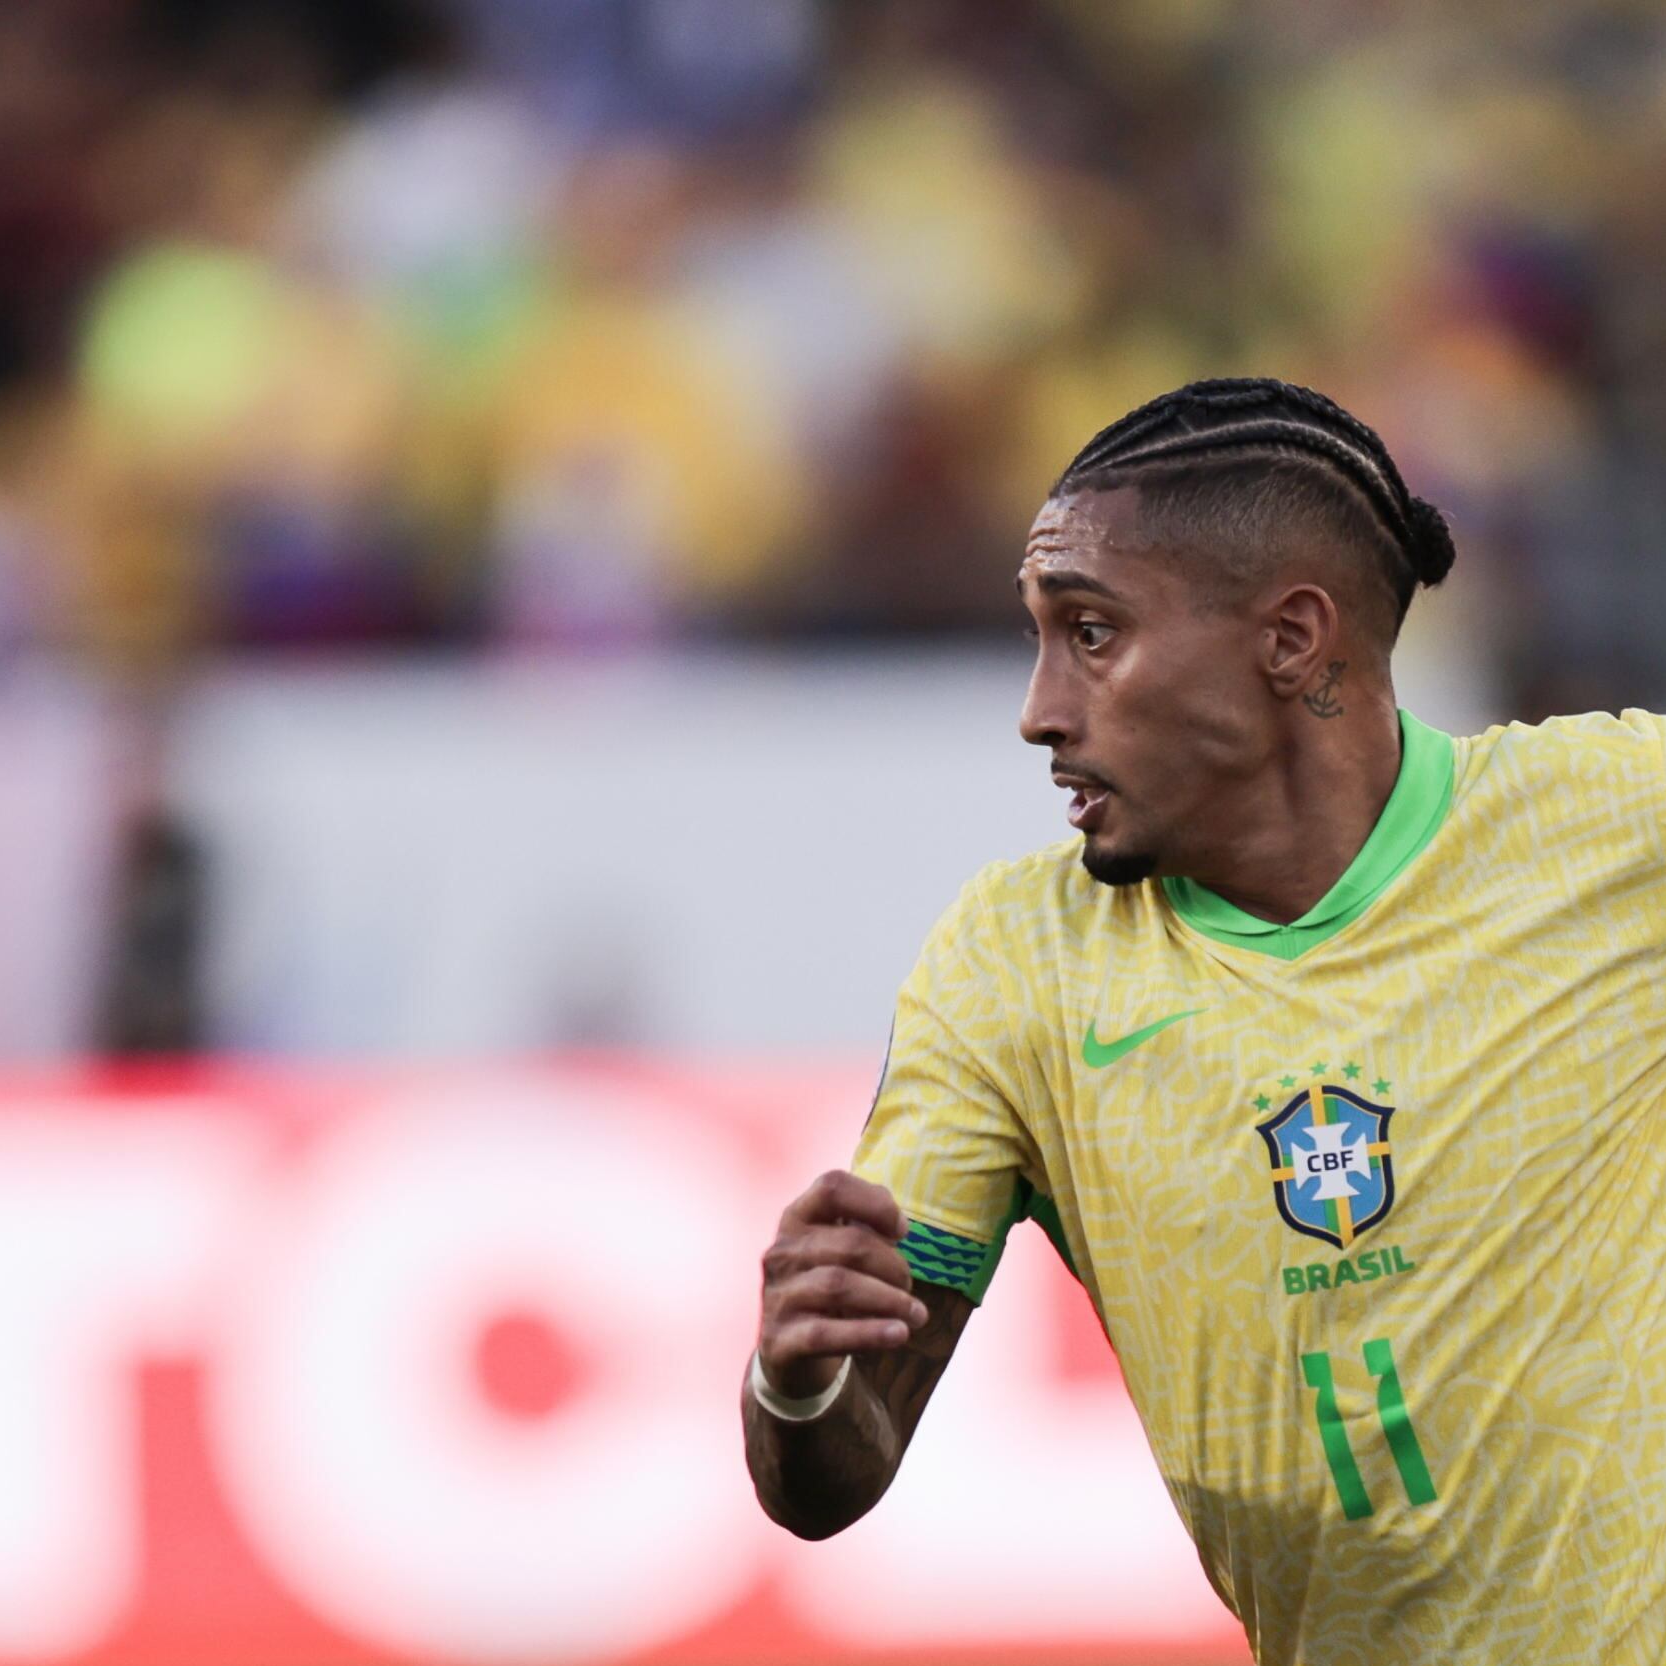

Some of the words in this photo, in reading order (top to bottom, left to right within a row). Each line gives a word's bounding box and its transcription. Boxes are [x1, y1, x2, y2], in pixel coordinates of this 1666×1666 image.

[1307, 1150, 1354, 1173] CBF
[1283, 1245, 1415, 1295] BRASIL
[1300, 1338, 1437, 1521] 11
